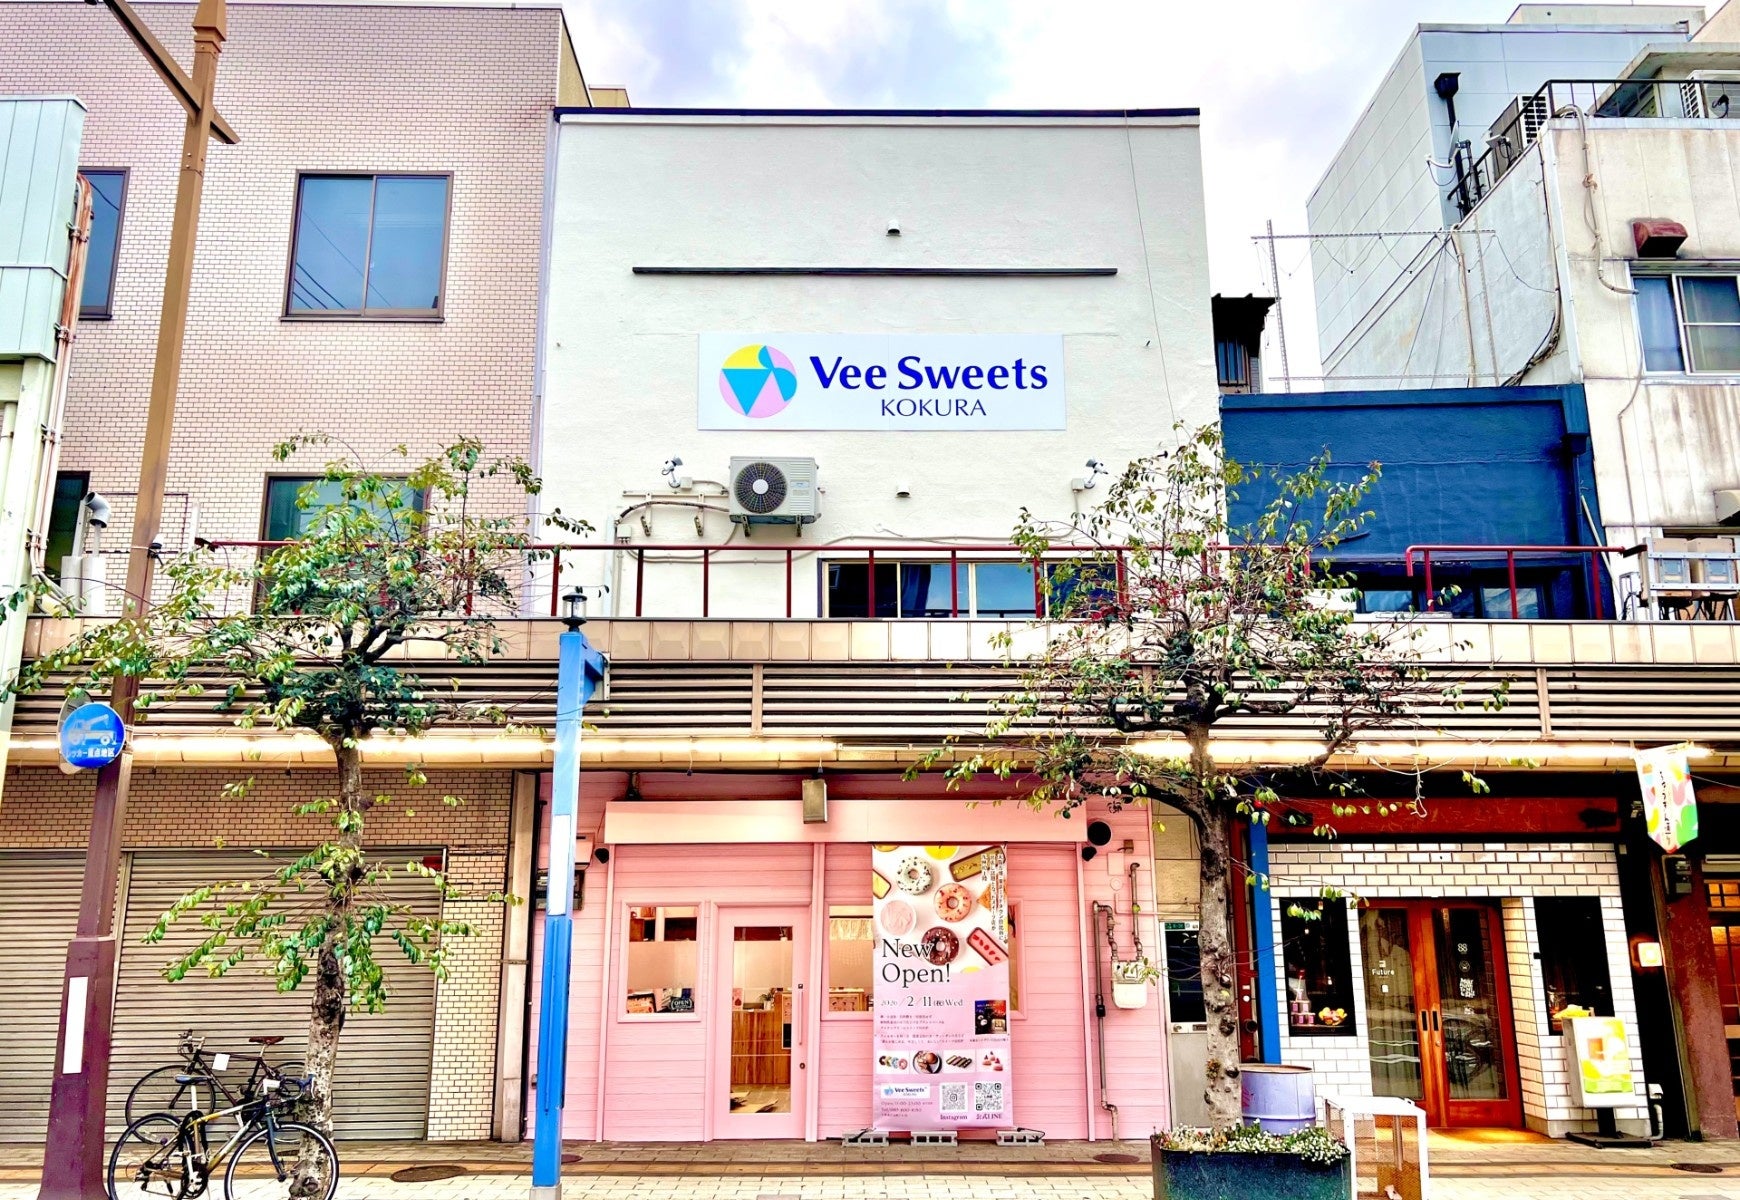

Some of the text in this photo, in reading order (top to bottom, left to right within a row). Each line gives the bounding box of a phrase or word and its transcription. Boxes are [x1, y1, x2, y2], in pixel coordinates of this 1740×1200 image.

[809, 355, 1048, 390] Vee Sweets
[881, 398, 987, 417] KOKURA
[882, 938, 934, 958] New
[882, 963, 951, 988] Open!
[1371, 968, 1395, 976] Future
